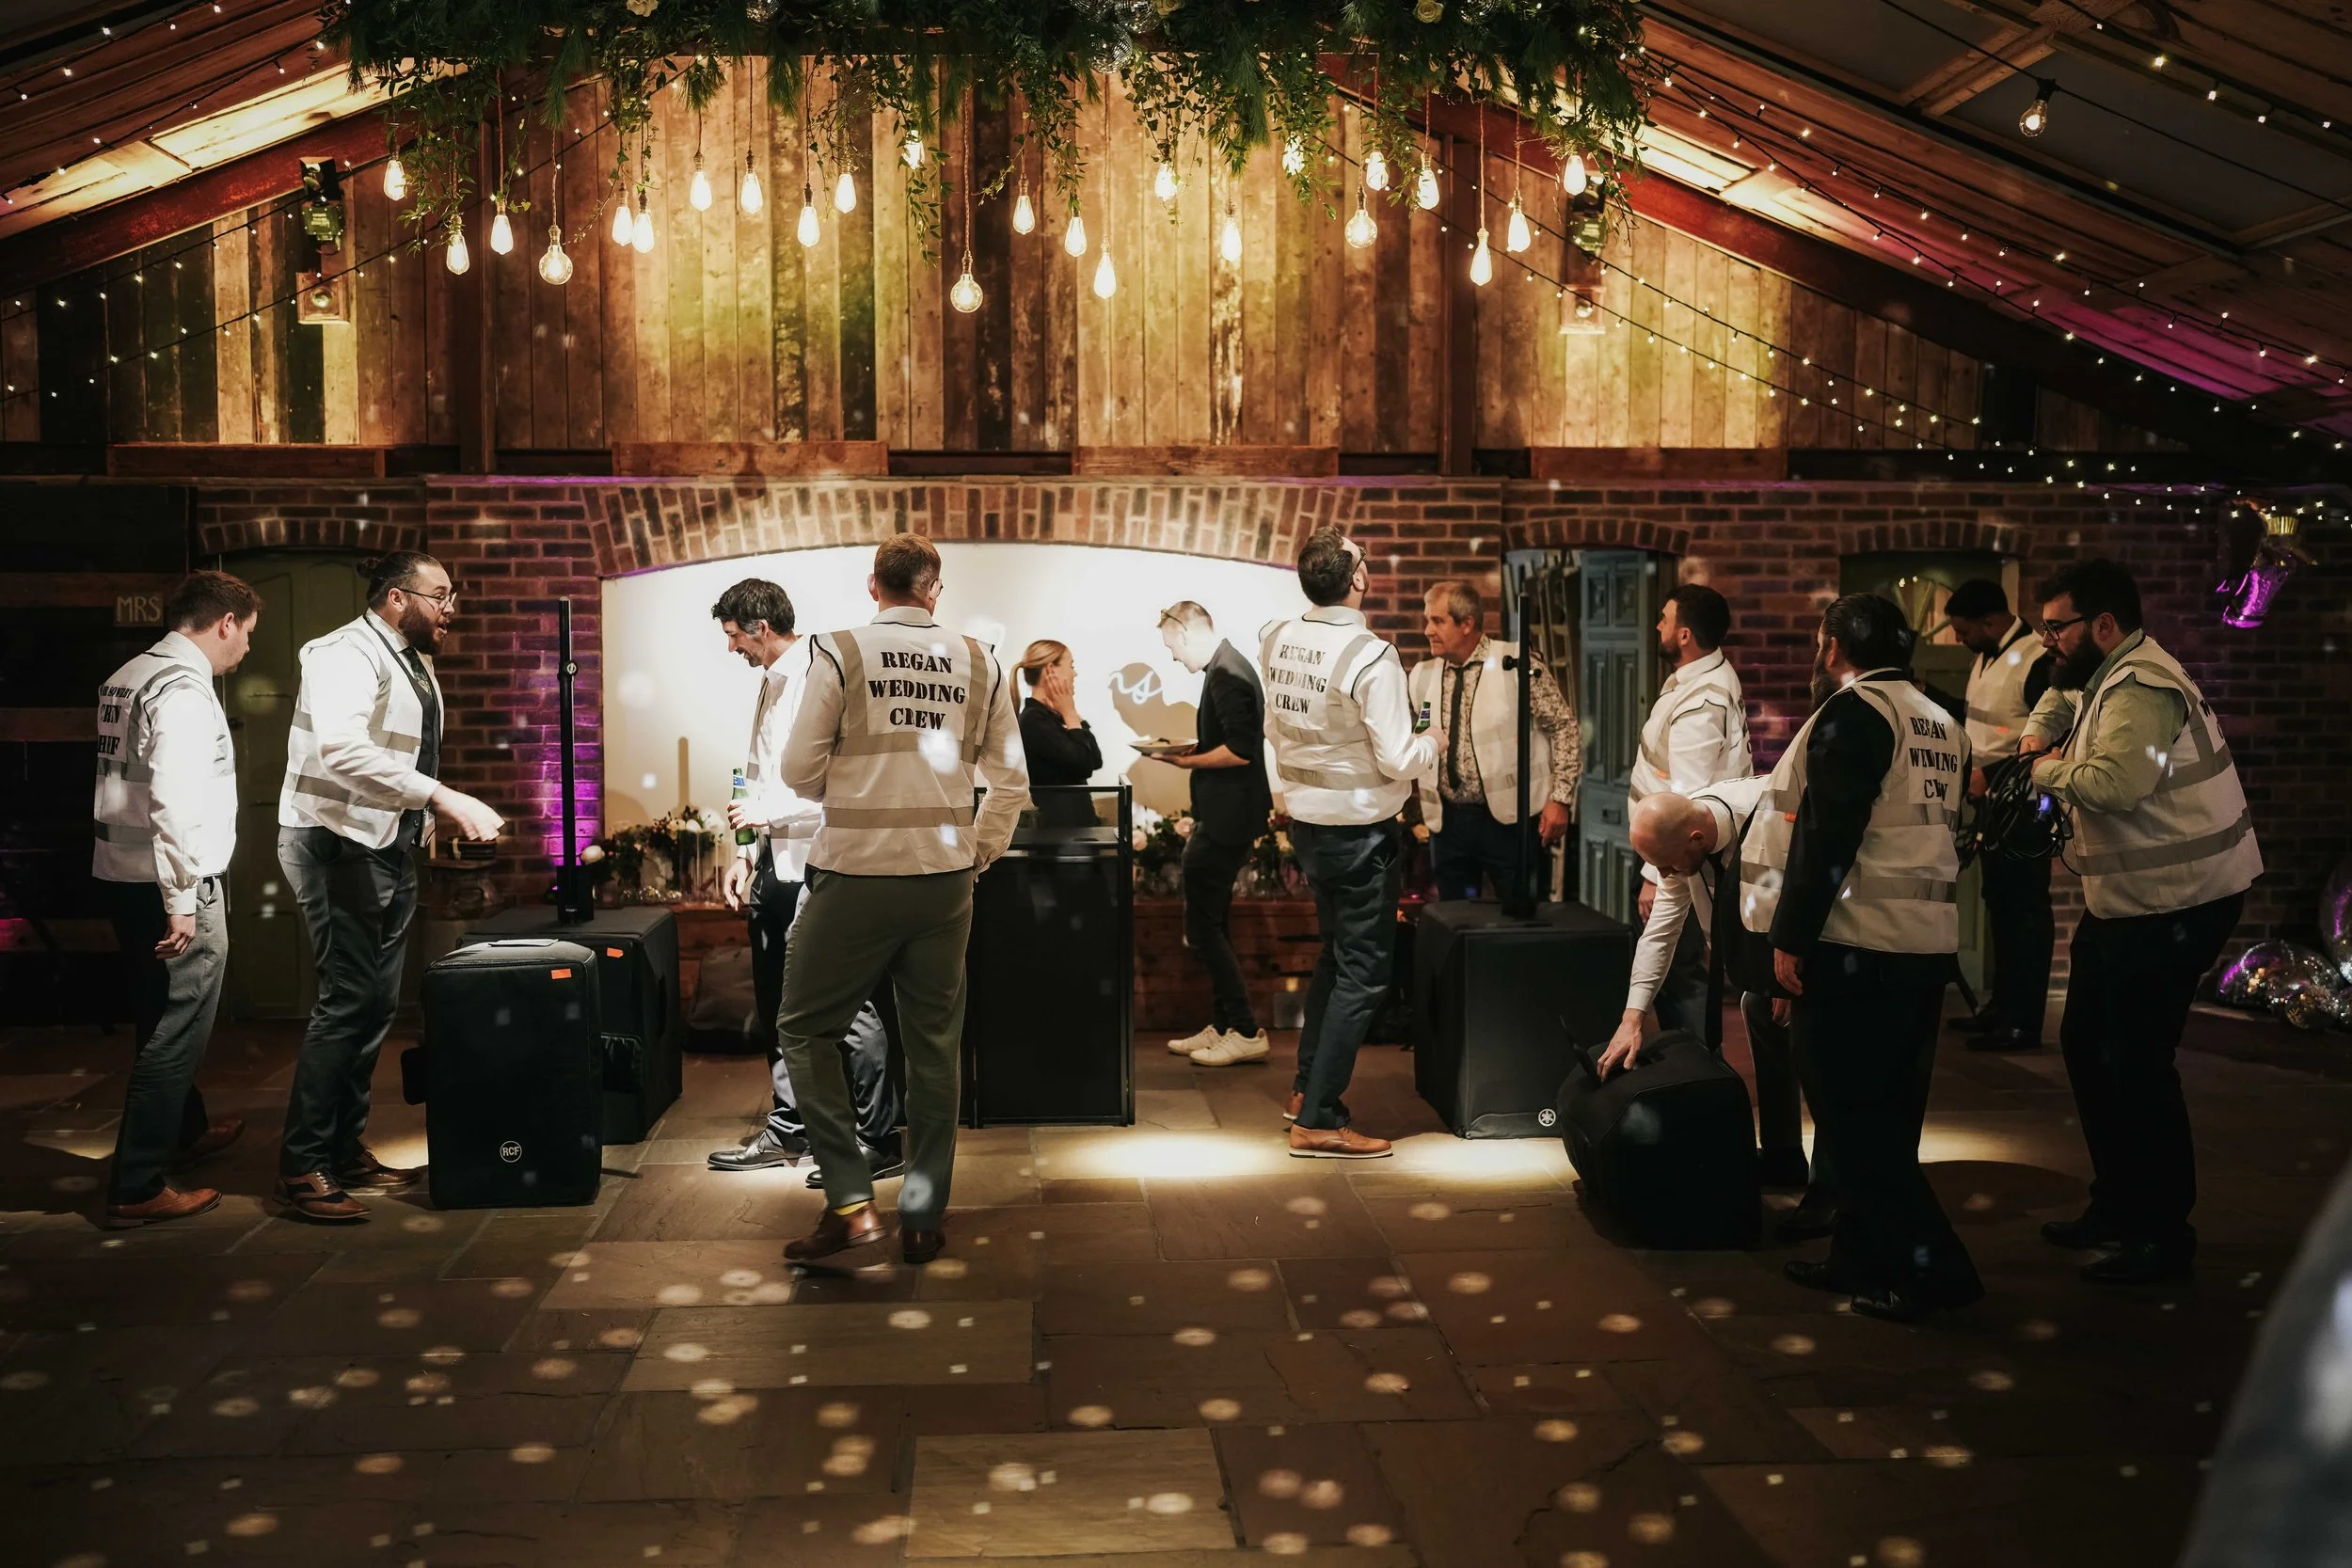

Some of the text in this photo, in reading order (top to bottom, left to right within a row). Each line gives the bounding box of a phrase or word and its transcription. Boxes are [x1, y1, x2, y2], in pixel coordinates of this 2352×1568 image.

[116, 595, 161, 623] MRS
[881, 651, 952, 673] REGAN
[867, 679, 966, 705] WEDDING
[1276, 693, 1311, 715] CREW
[889, 707, 946, 731] CREW
[501, 1146, 520, 1157] RCF
